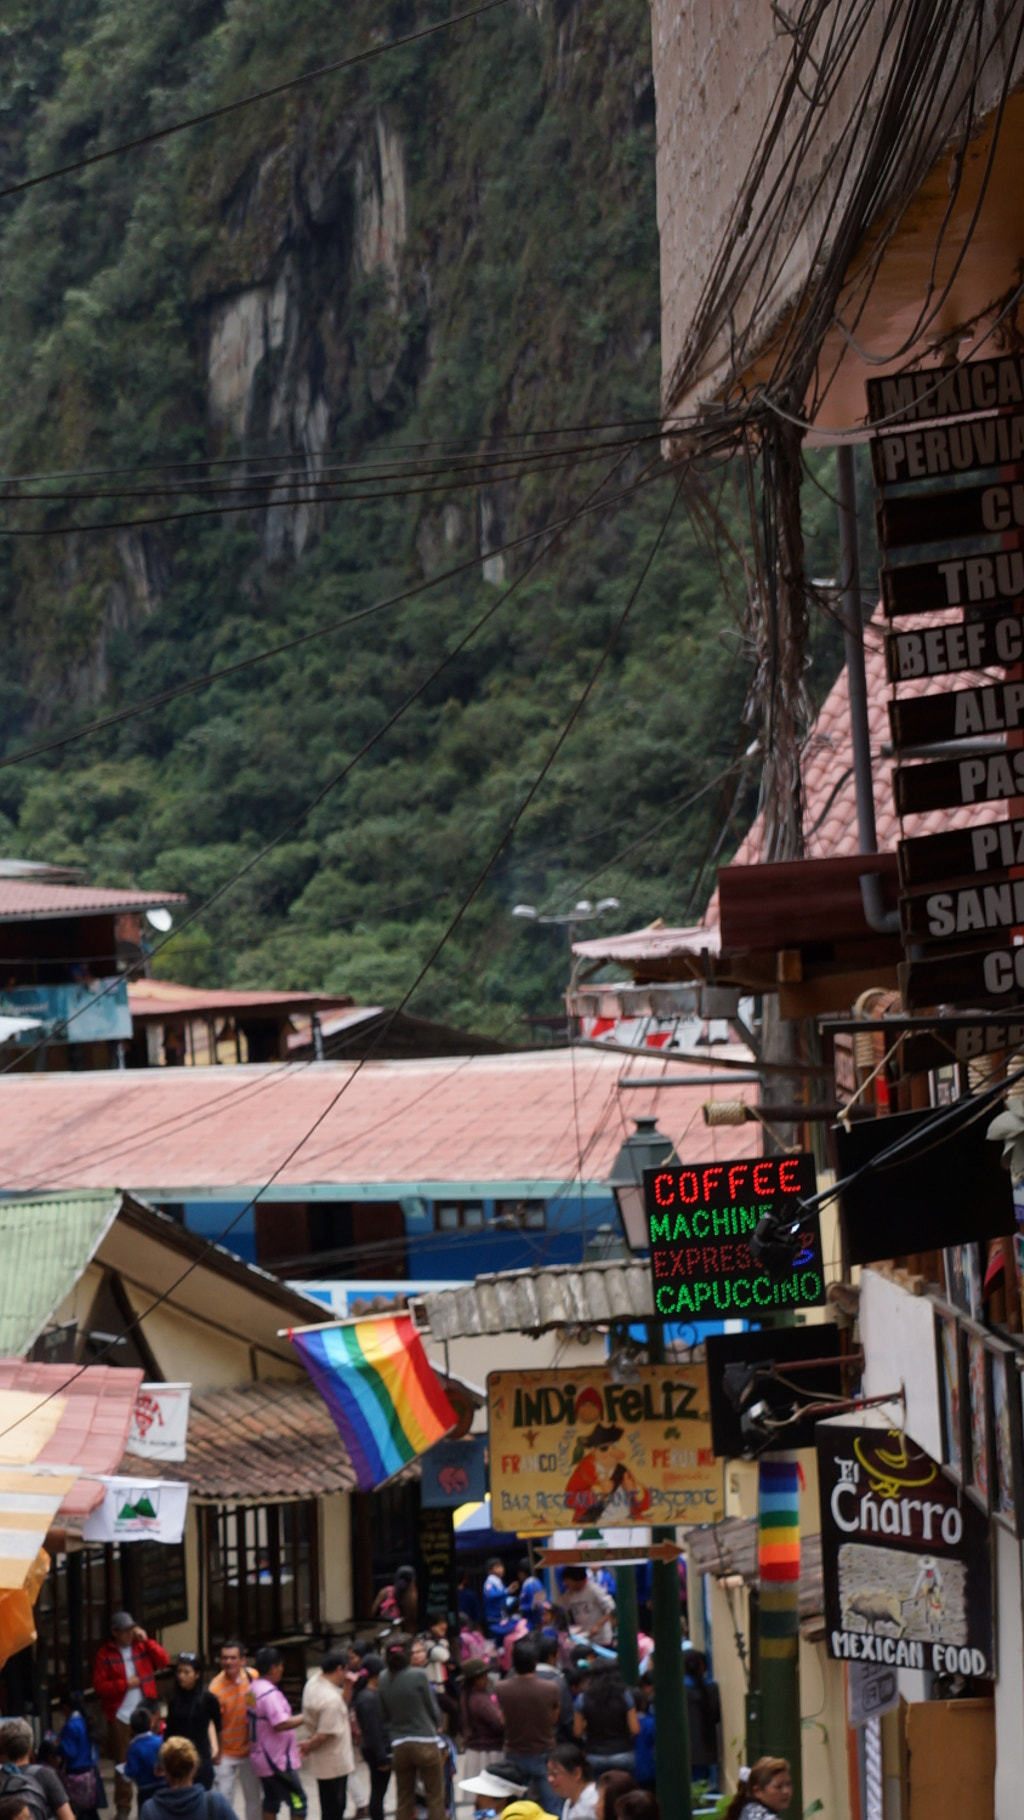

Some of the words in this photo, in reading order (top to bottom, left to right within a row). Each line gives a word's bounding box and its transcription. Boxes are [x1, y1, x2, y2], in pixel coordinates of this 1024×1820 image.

[880, 357, 1024, 424] MEXICA
[896, 623, 987, 680] BEEF
[654, 1159, 802, 1207] COFFEE
[656, 1271, 822, 1315] CAPUCCINO
[501, 1454, 558, 1475] FRANCO
[834, 1456, 860, 1484] El
[831, 1483, 963, 1545] Charro
[831, 1631, 924, 1669] MEXICAN
[932, 1644, 986, 1675] FOOD
